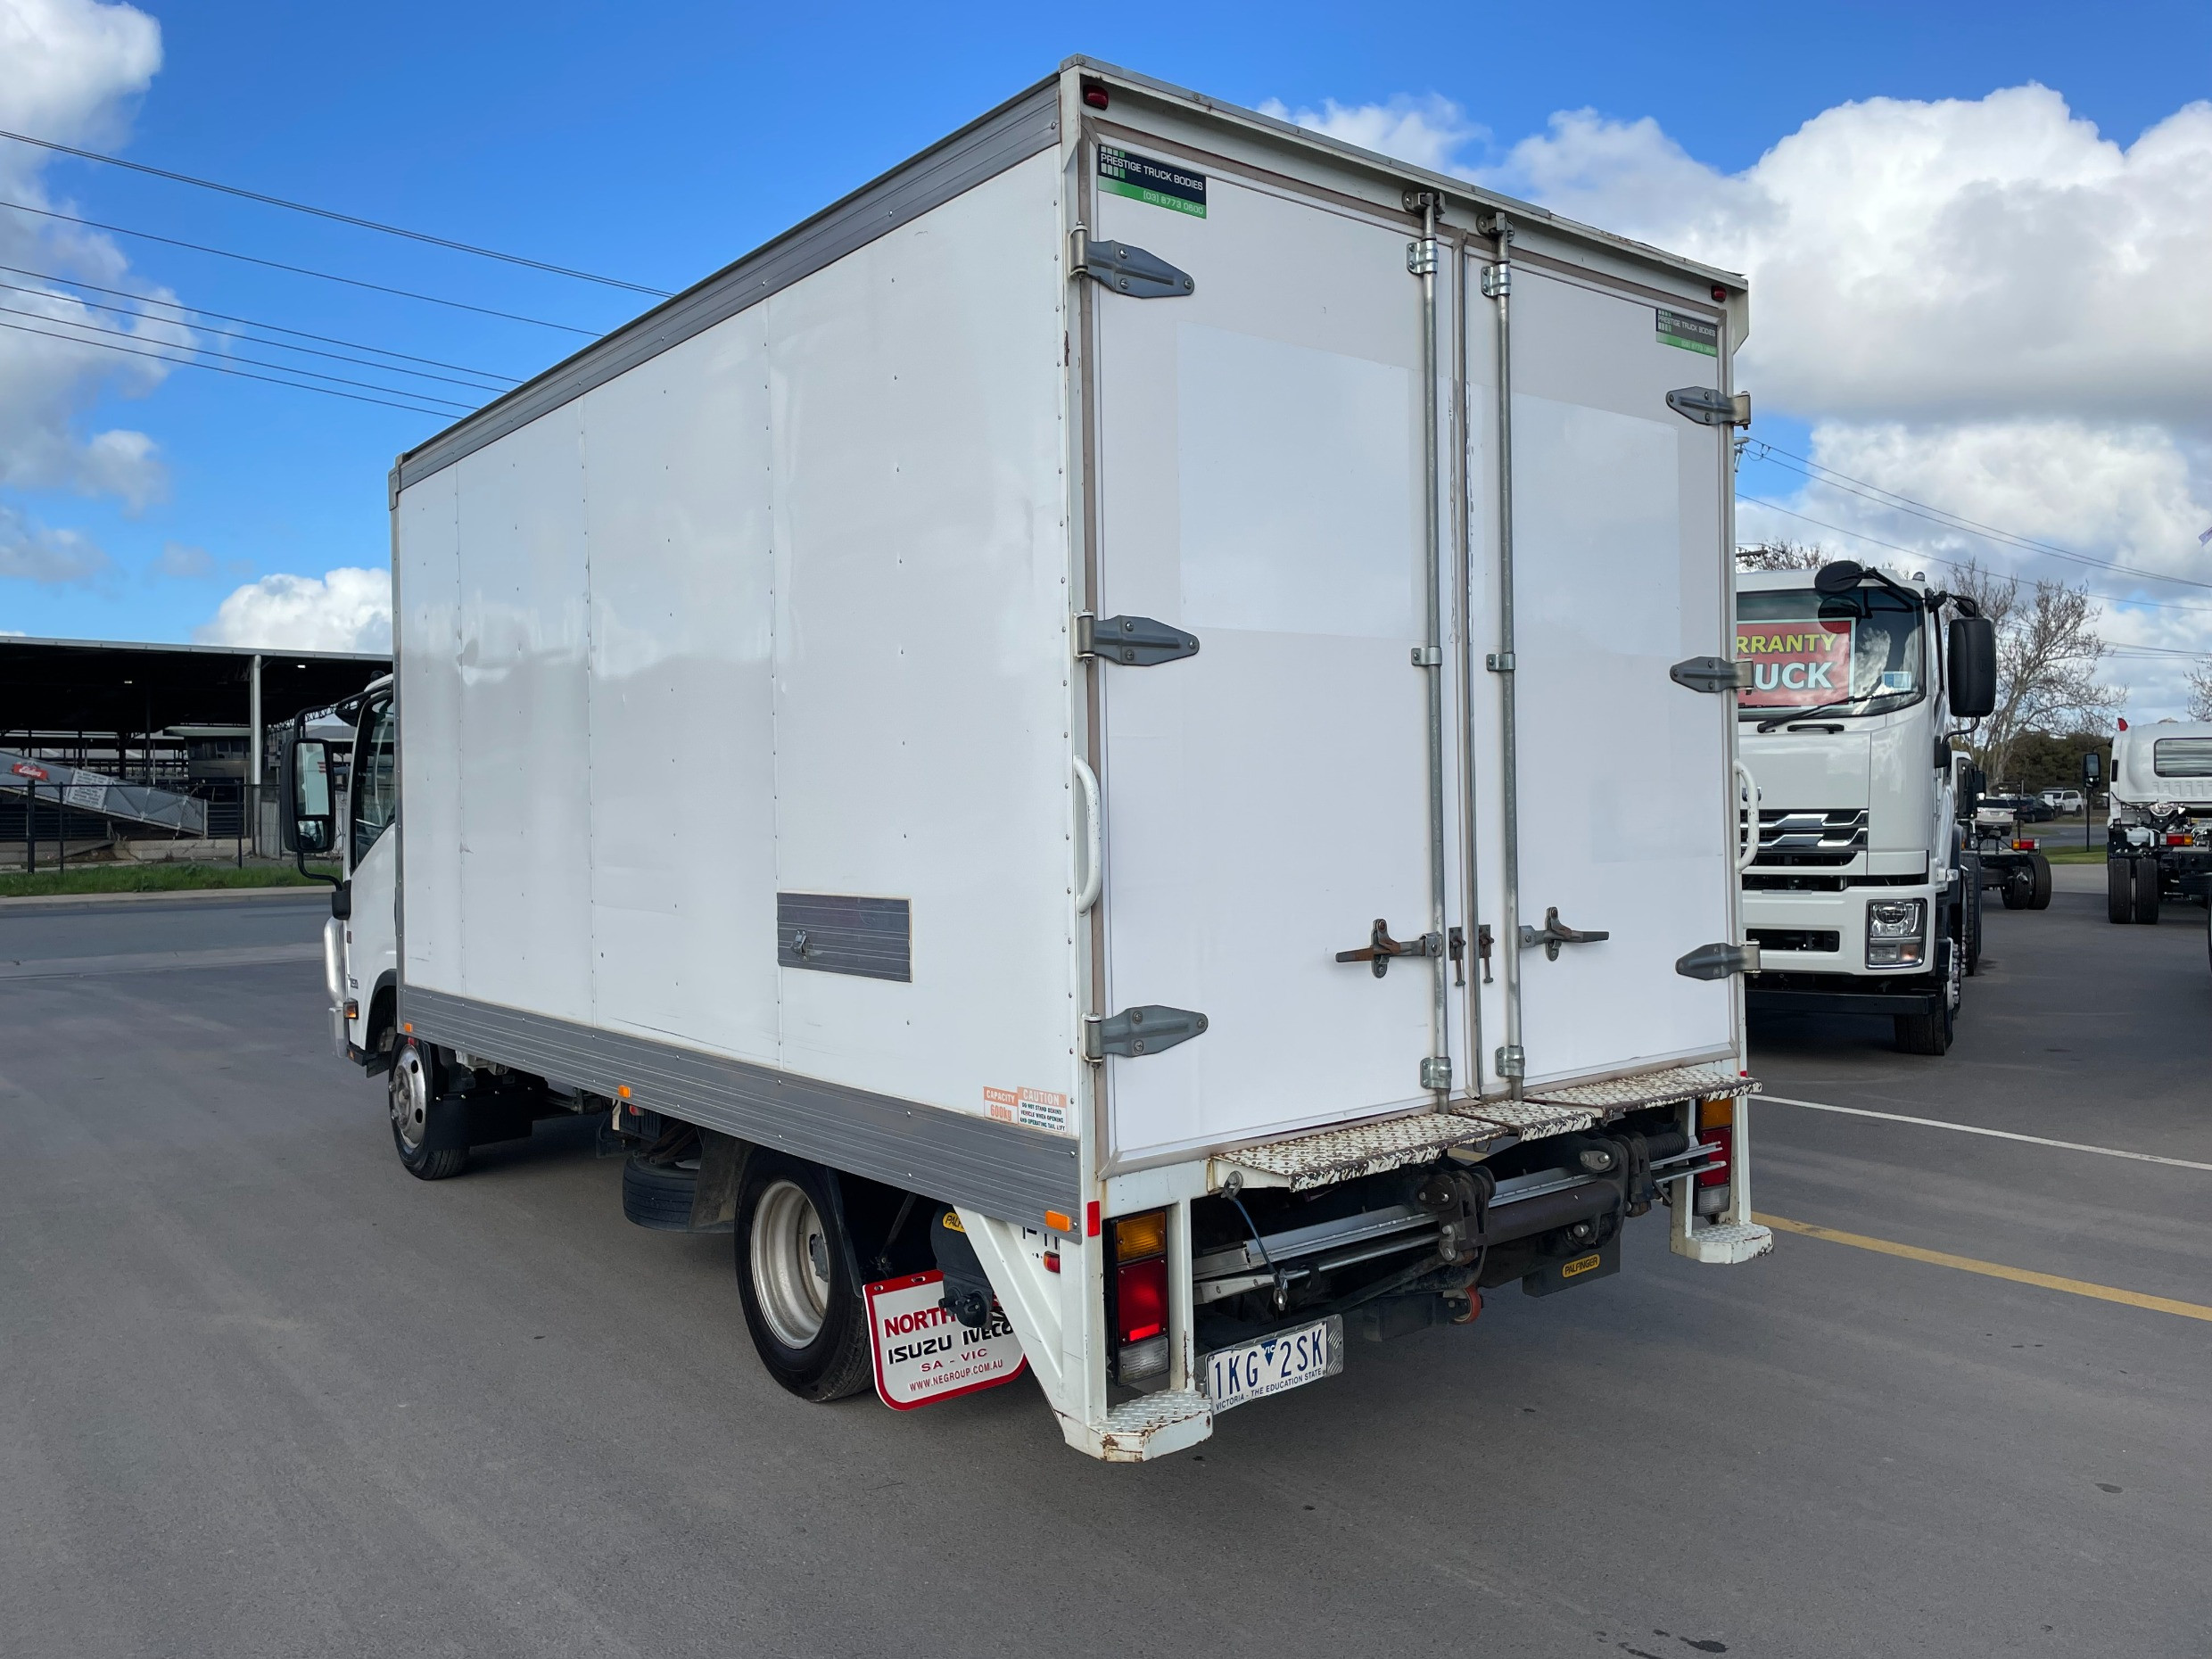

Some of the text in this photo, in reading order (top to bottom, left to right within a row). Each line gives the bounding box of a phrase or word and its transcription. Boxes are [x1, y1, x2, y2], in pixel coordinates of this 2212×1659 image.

[1101, 153, 1203, 191] PRESTIGE TRUCK BODIES
[1143, 189, 1160, 203] (03)
[1160, 195, 1182, 209] 8773
[1657, 315, 1716, 337] PRESTIGE TRUCK BODIES
[986, 1089, 1016, 1103] CAPACITY
[1023, 1088, 1060, 1106] CAUTION
[990, 1104, 1012, 1121] 600kg
[1020, 1110, 1064, 1124] VEHICLE WHEN OPENING
[1028, 1118, 1047, 1128] OPERATING
[1564, 1257, 1598, 1275] PALFINGER
[887, 1321, 1014, 1365] ISUZU IVECO
[920, 1359, 944, 1372] SA
[961, 1348, 988, 1362] VIC
[1214, 1328, 1323, 1400] 1KG 2SK
[909, 1359, 1003, 1392] WWW.NEGROUP.COM.AU
[1216, 1394, 1244, 1411] VICTORIA
[1250, 1387, 1264, 1398] THE
[1266, 1375, 1303, 1393] EDUCATION
[1304, 1367, 1322, 1381] STATE
